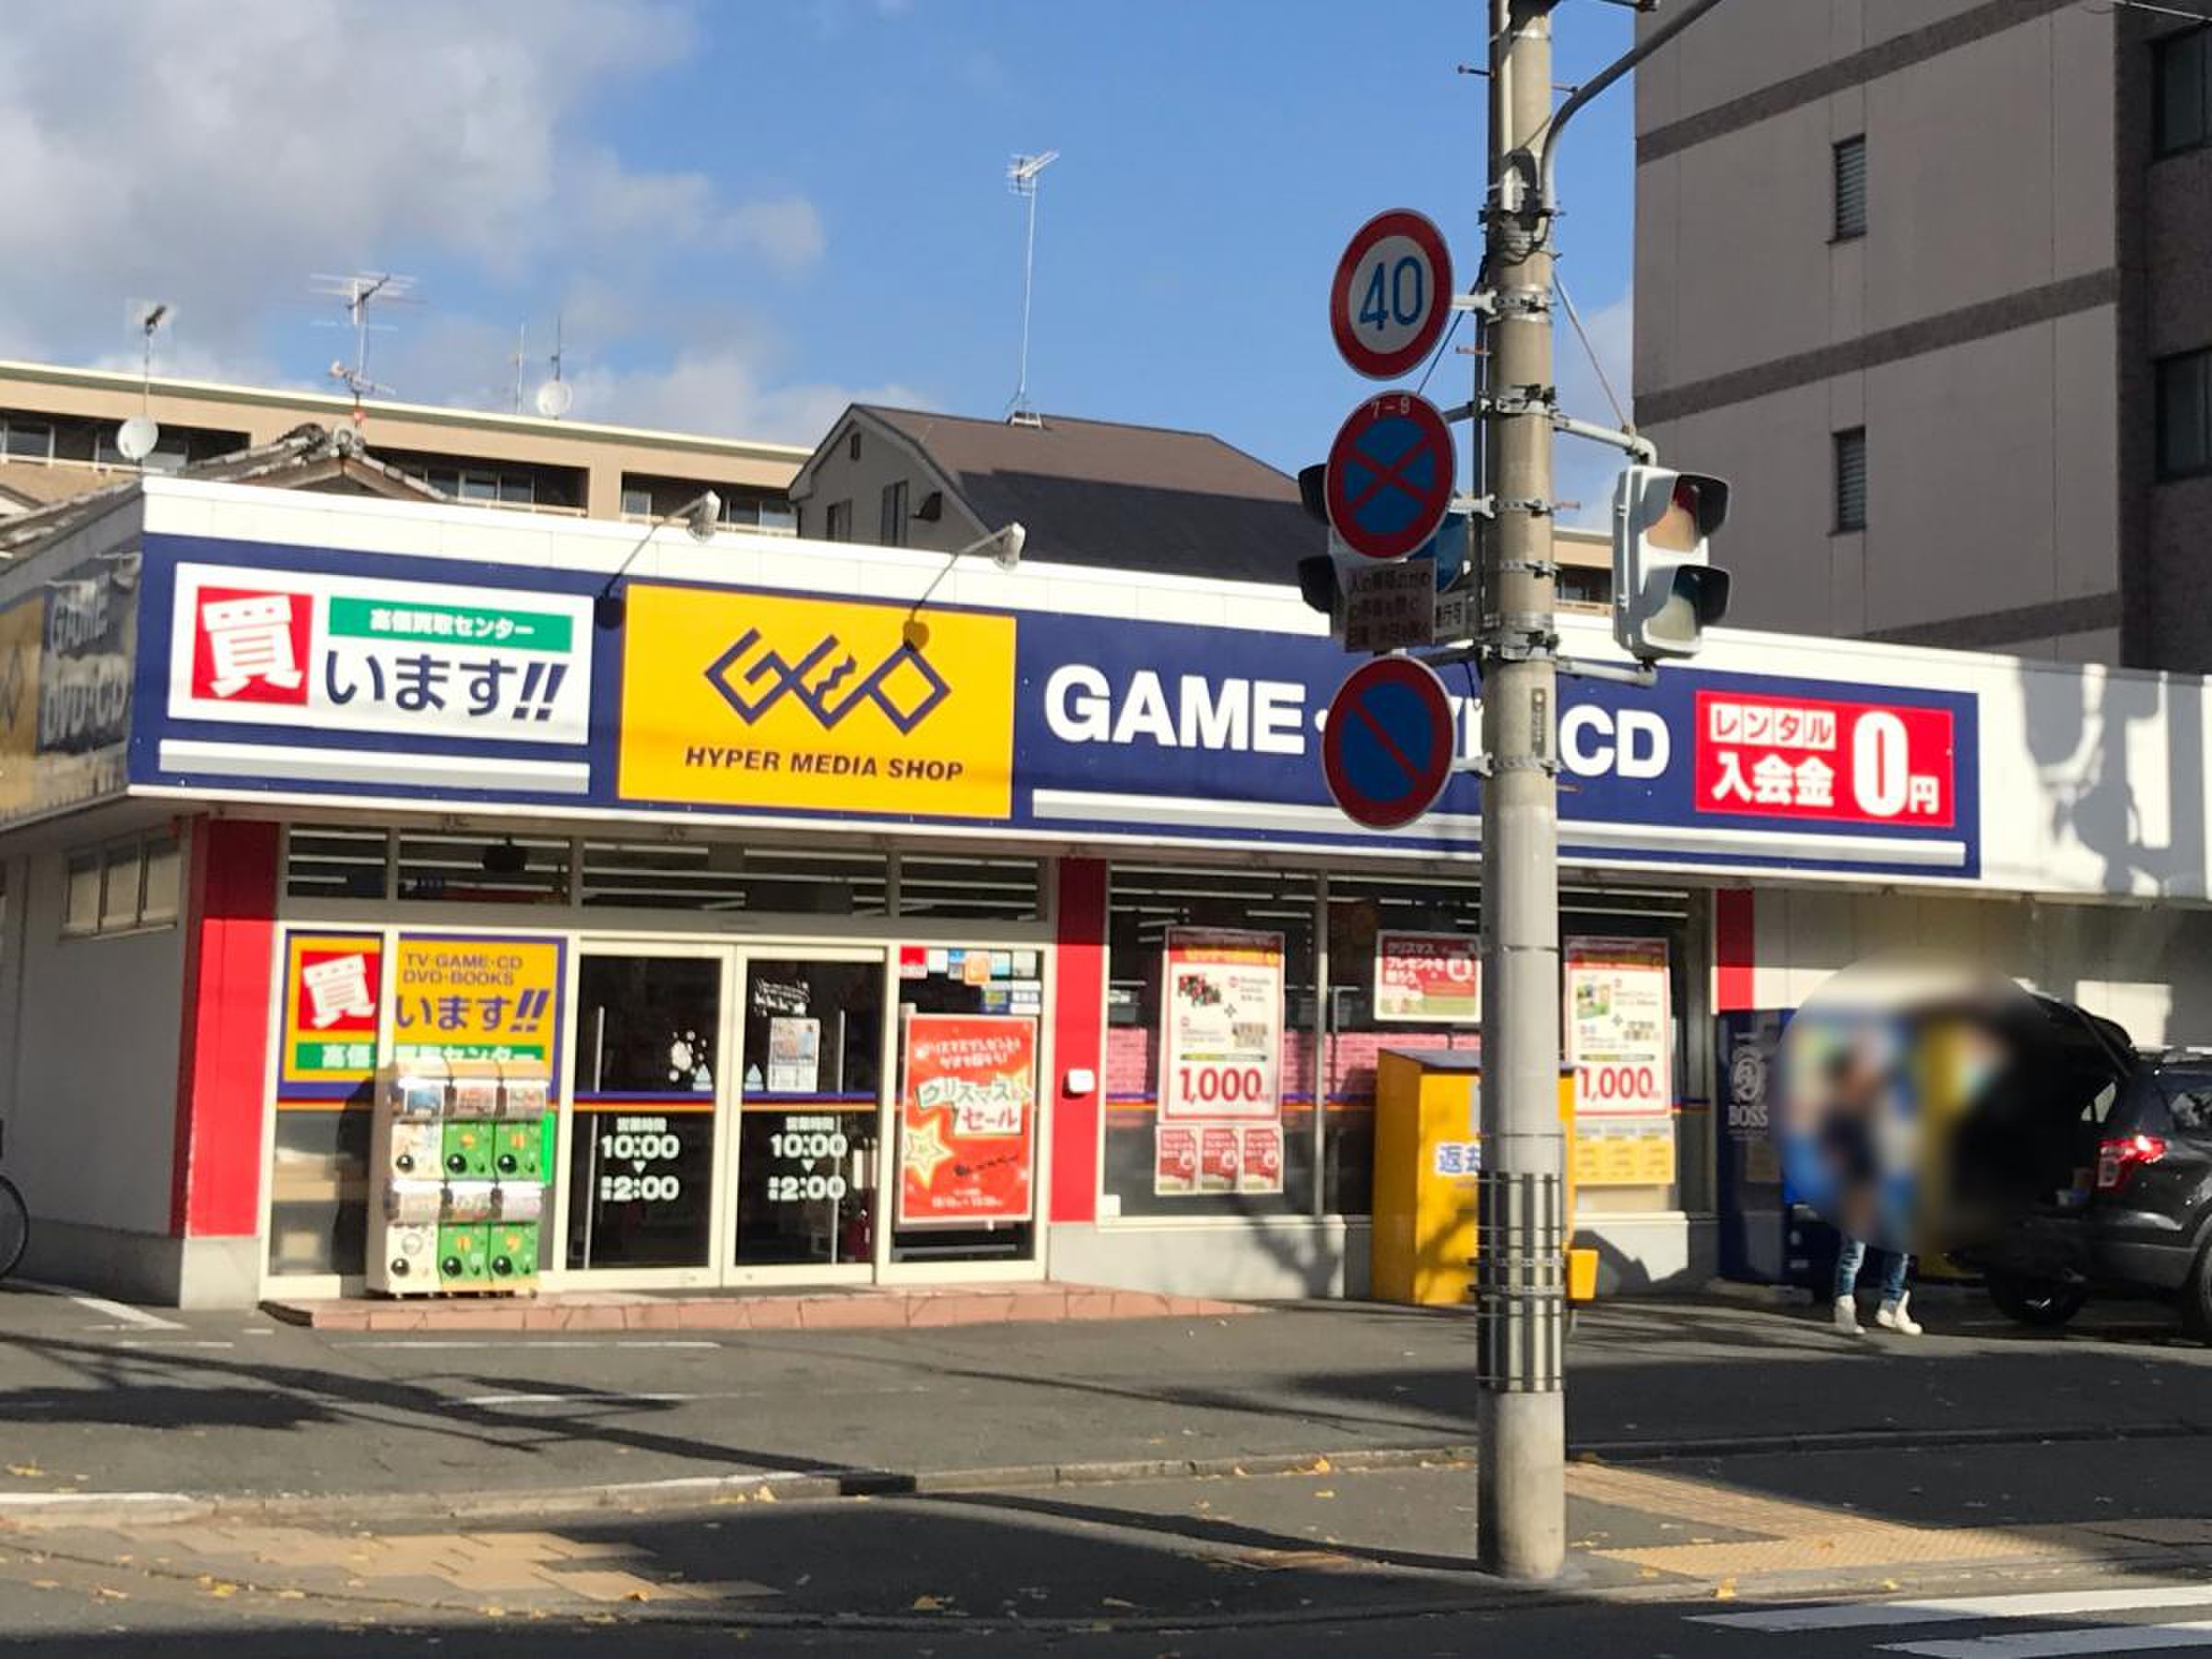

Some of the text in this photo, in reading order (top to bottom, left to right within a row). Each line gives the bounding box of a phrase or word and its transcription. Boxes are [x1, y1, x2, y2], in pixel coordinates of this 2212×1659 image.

[1359, 256, 1423, 331] 40
[704, 627, 951, 735] GEO
[1714, 707, 1832, 745] レンタル
[685, 746, 964, 782] HYPER MEDIA SHOP
[1712, 751, 1834, 807] 入会金
[1178, 1066, 1263, 1104] 1,000
[1578, 1065, 1653, 1101] 1,000
[1727, 1105, 1769, 1128] BOSS
[600, 1135, 680, 1159] 10:00
[770, 1134, 848, 1159] 10:00
